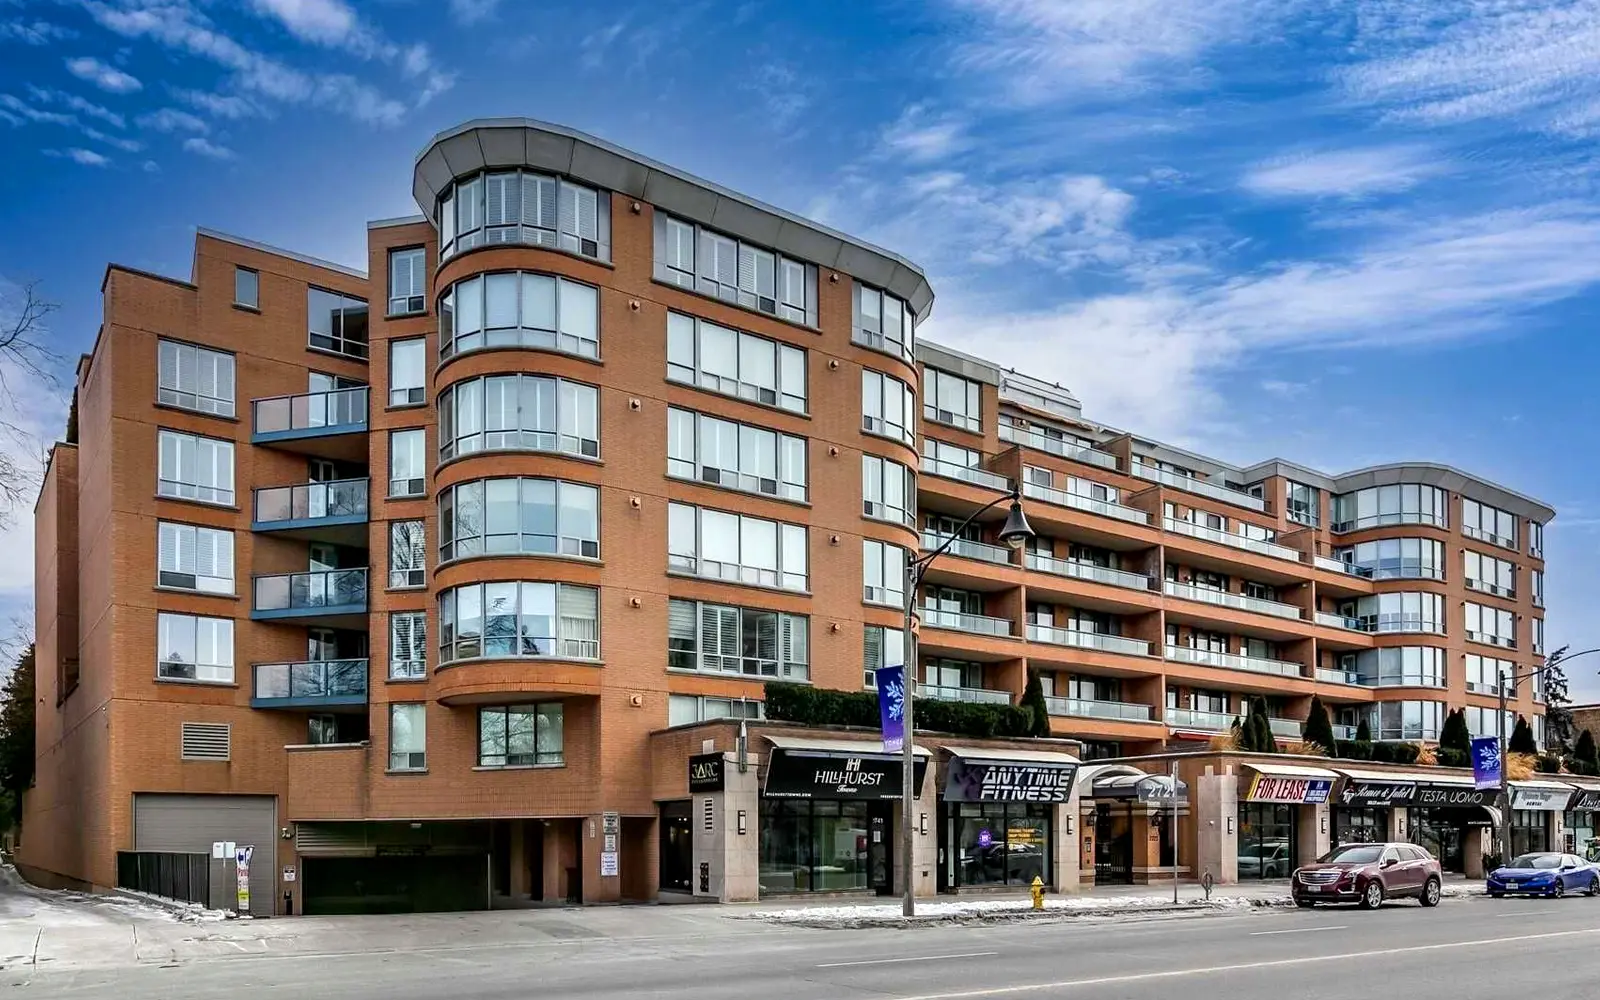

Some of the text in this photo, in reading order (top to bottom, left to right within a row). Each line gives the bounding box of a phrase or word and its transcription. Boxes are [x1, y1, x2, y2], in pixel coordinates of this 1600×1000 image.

[814, 770, 884, 785] HILLHURST
[982, 766, 1071, 786] ANYTIME
[981, 785, 1066, 800] FITNESS
[1254, 778, 1309, 800] FOR LEASE
[1420, 790, 1483, 804] TESTA UOMO
